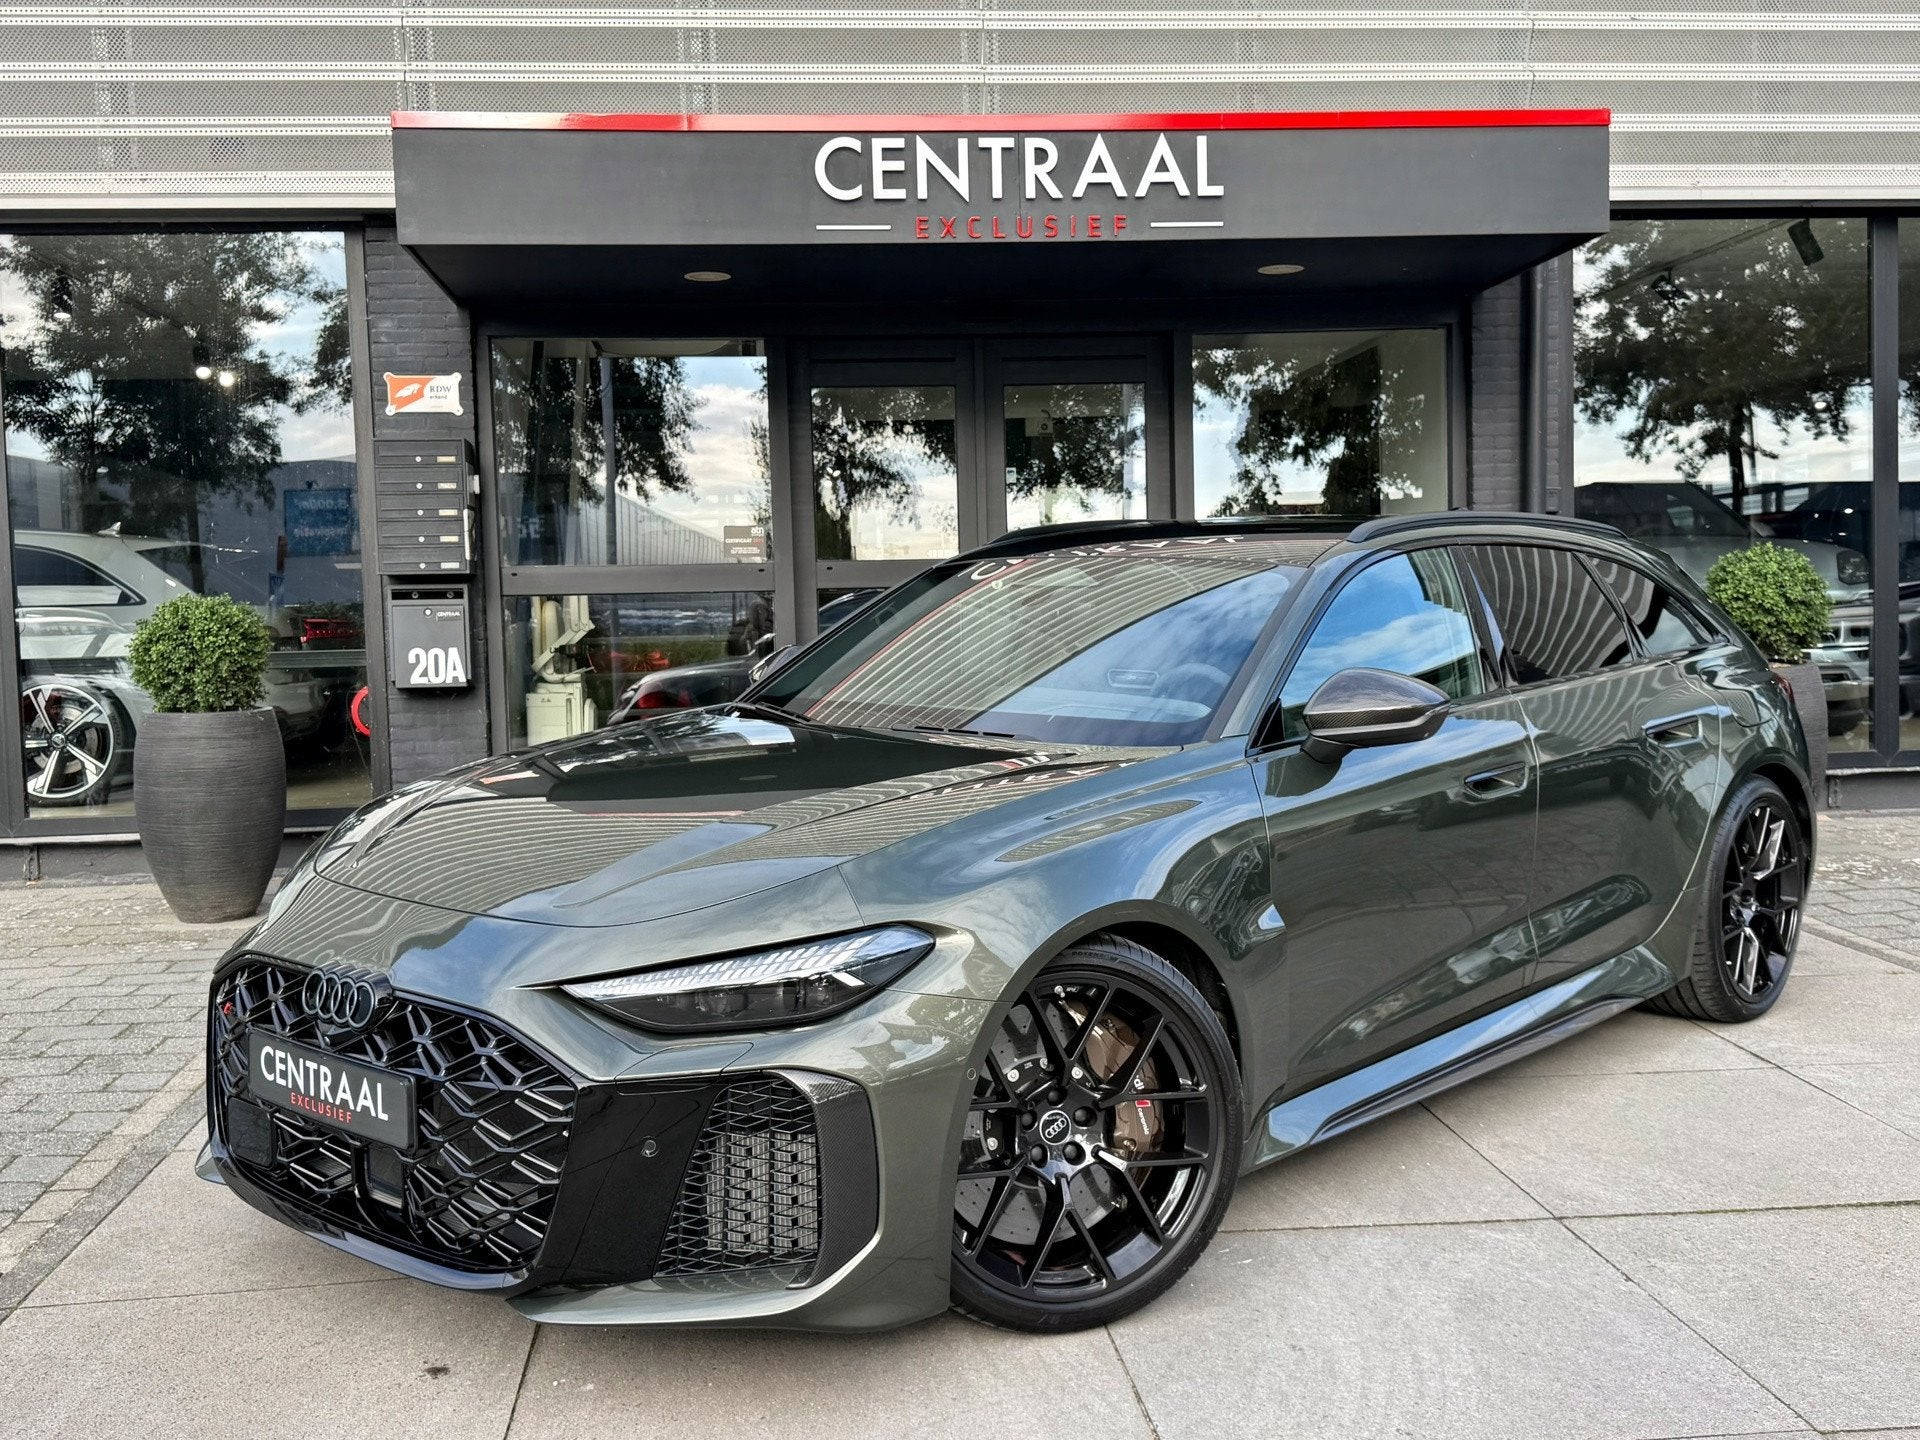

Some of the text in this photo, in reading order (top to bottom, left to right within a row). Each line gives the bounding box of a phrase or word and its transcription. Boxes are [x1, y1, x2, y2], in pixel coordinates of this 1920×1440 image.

[814, 132, 1225, 202] CENTRAAL
[915, 214, 1128, 239] EXCLUSIEF
[429, 385, 452, 393] RDW
[408, 647, 467, 685] 20A
[260, 1045, 389, 1122] CENTRAAL
[290, 1091, 352, 1124] EXCLUSIEF
[1138, 1108, 1150, 1135] ceramic
